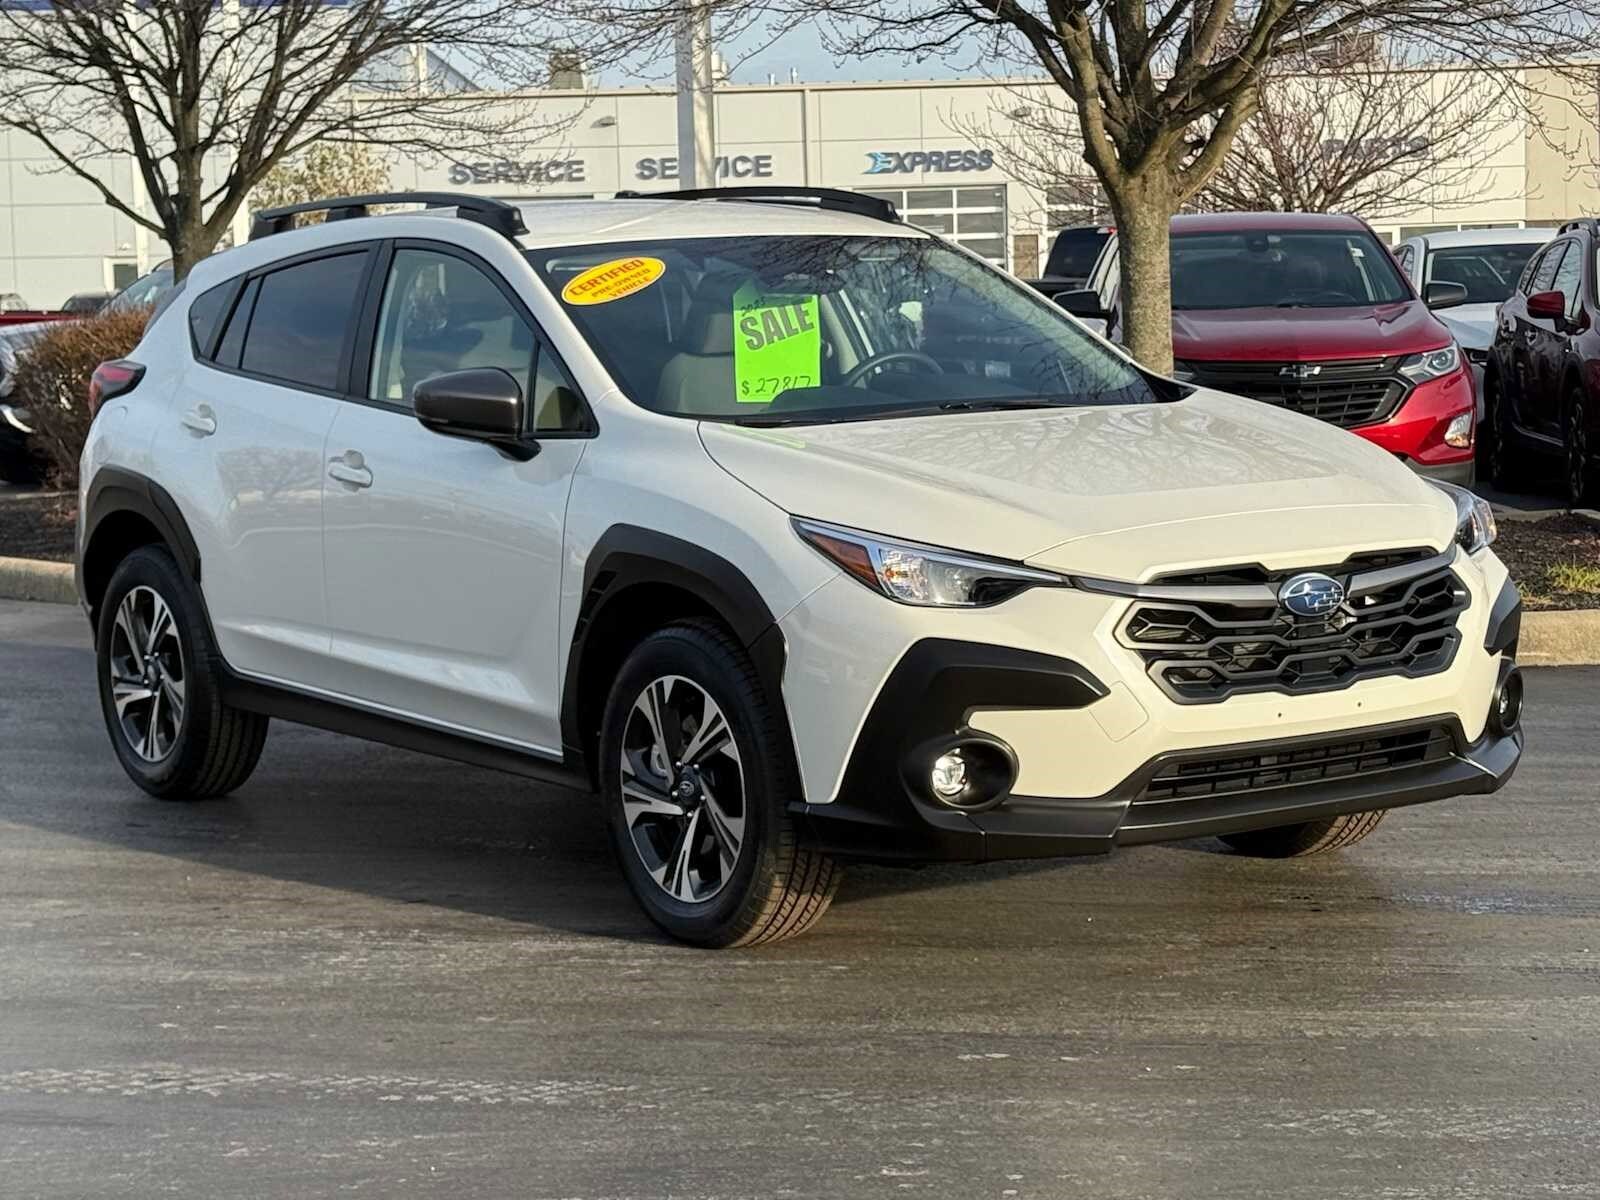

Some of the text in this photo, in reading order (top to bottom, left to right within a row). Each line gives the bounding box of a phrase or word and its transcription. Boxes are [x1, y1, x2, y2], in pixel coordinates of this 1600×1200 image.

[448, 160, 586, 185] SERVICE
[635, 155, 774, 181] SEICE
[862, 149, 993, 174] EXPRESS
[569, 258, 645, 296] CERTIFIED
[608, 276, 651, 298] VEHICLE
[740, 296, 815, 351] SALE
